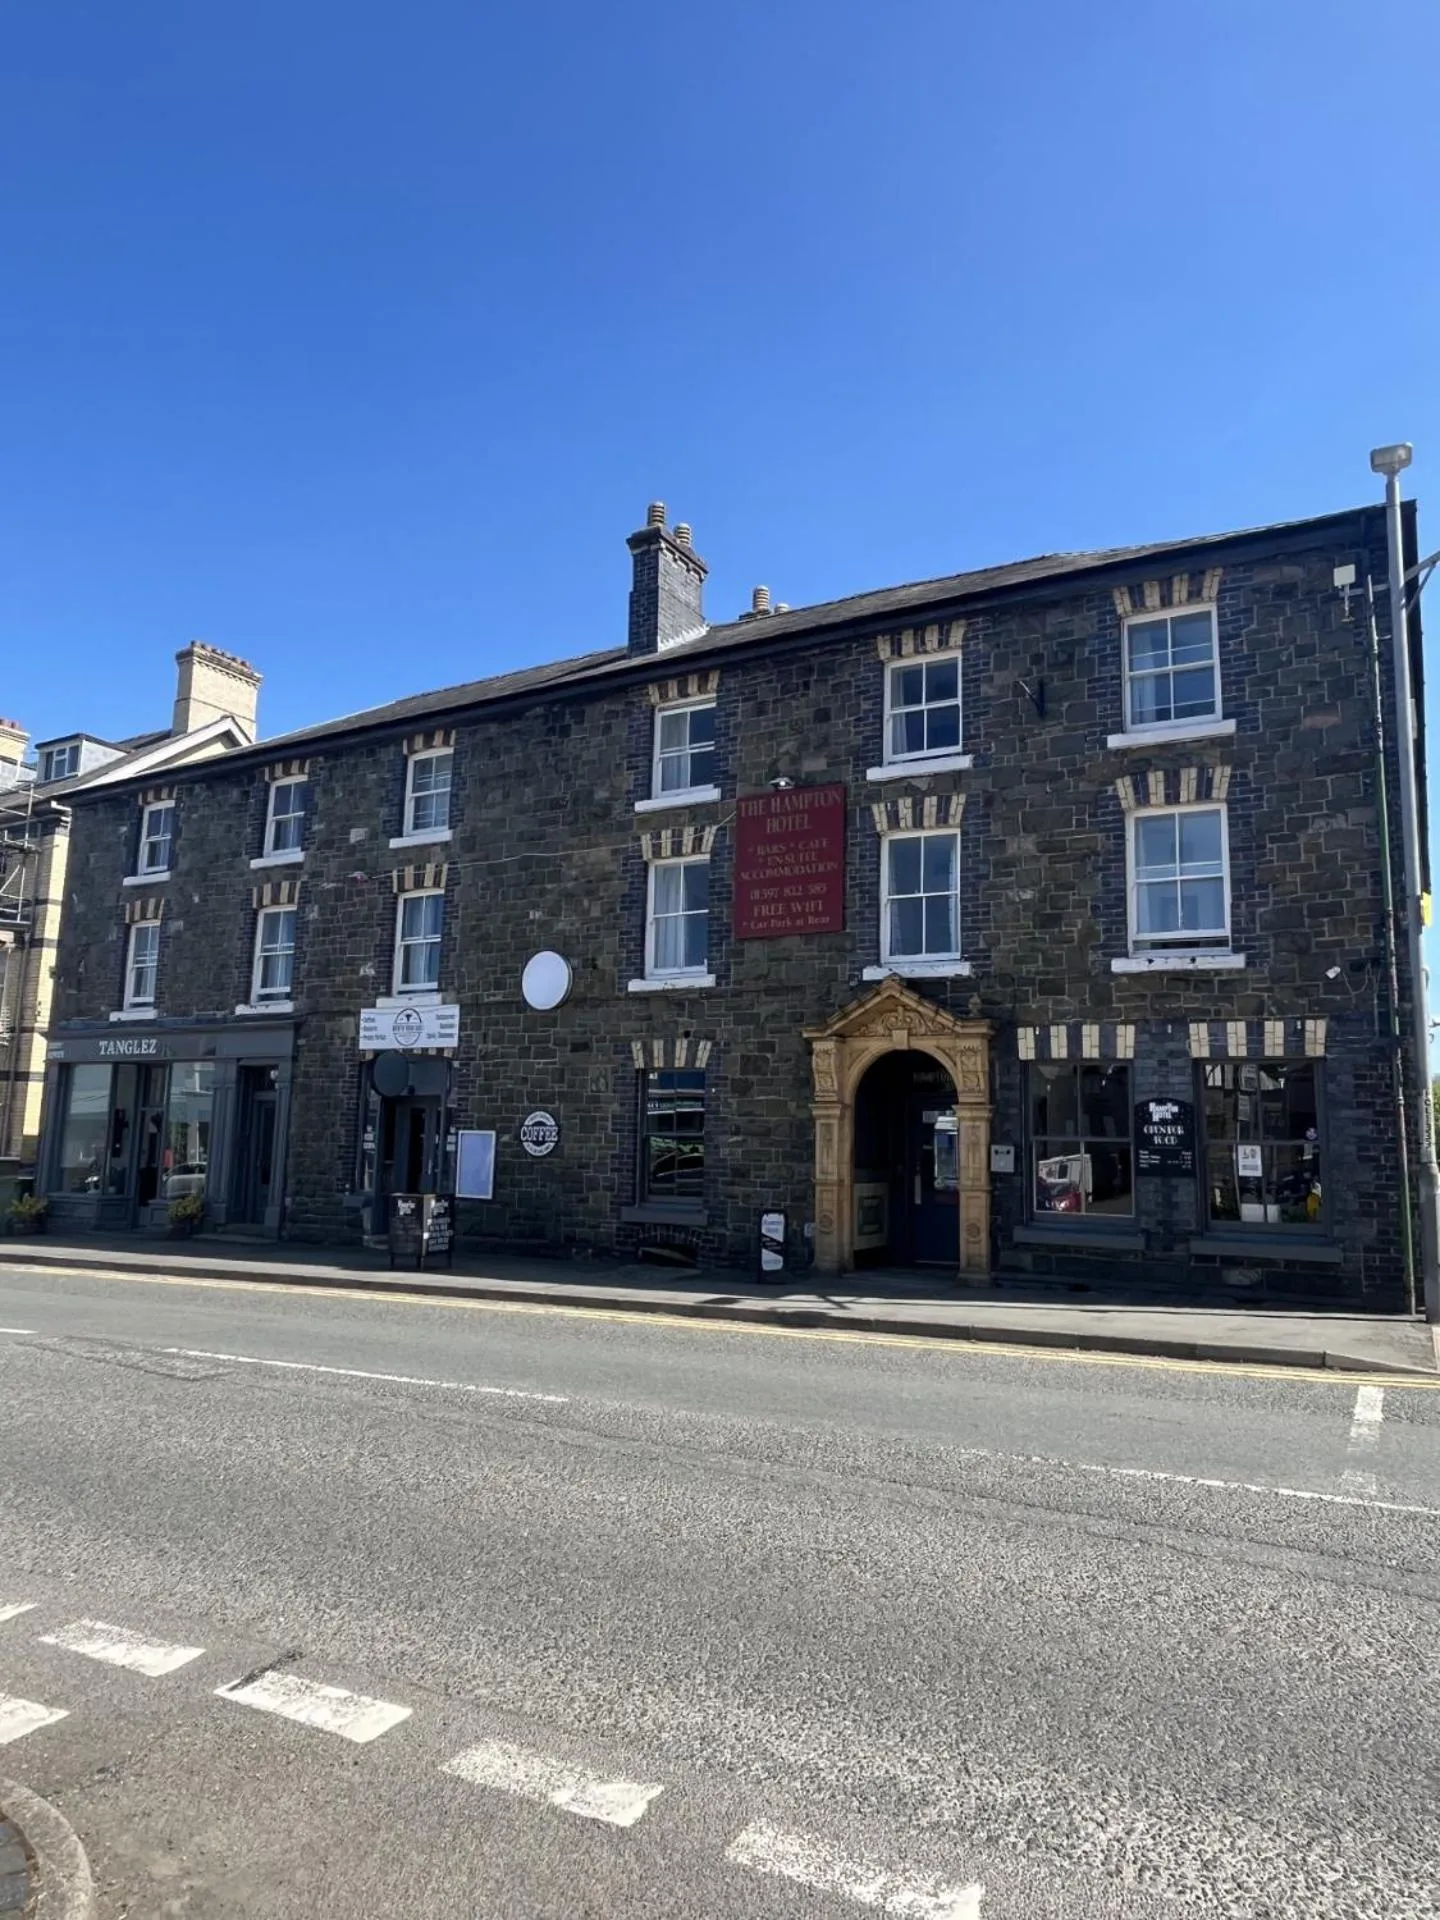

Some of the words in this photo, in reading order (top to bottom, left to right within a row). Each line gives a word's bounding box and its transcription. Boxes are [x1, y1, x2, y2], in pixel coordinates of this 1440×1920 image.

[740, 800, 766, 818] THE
[770, 789, 841, 814] HAMPTON
[766, 813, 813, 834] HOTEL
[753, 903, 785, 918] FREE
[99, 1038, 157, 1056] TANGLEZ
[520, 1125, 559, 1142] COFFEE
